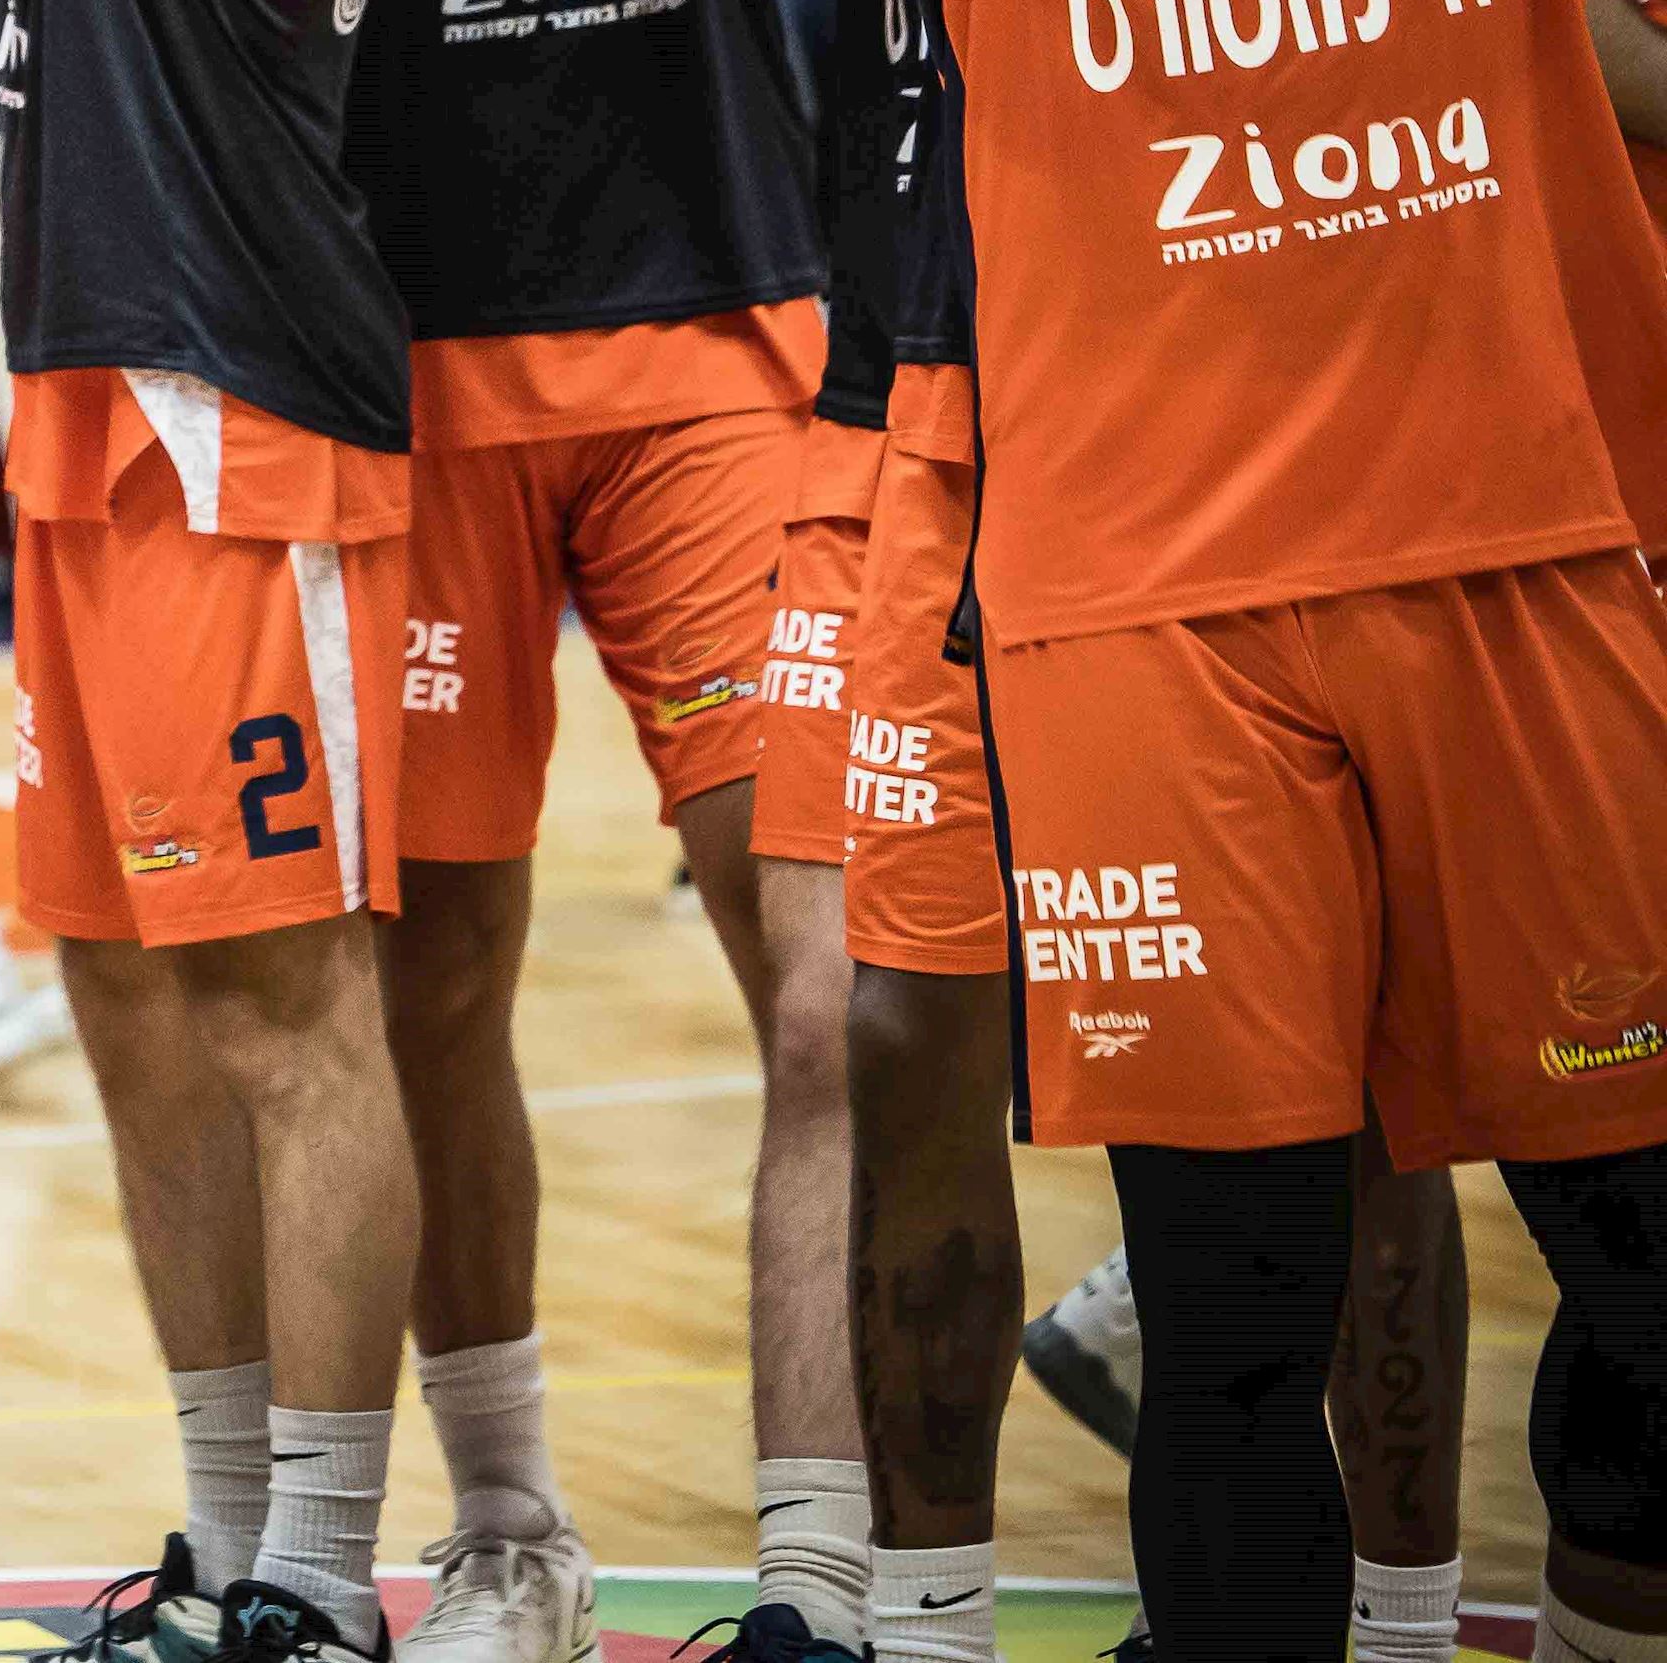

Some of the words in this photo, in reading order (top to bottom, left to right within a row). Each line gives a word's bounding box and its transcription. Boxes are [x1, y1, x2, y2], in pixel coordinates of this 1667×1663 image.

[1148, 96, 1491, 233] Ziona
[1293, 203, 1390, 241] בחצר
[1397, 175, 1502, 221] מסעדה
[1159, 224, 1284, 266] קסומה
[849, 709, 933, 772] ADE
[231, 713, 322, 861] 2
[1012, 861, 1182, 922] TRADE
[1024, 922, 1209, 983] ENTER
[1068, 1009, 1152, 1036] Reebok
[1558, 1036, 1664, 1073] Winner
